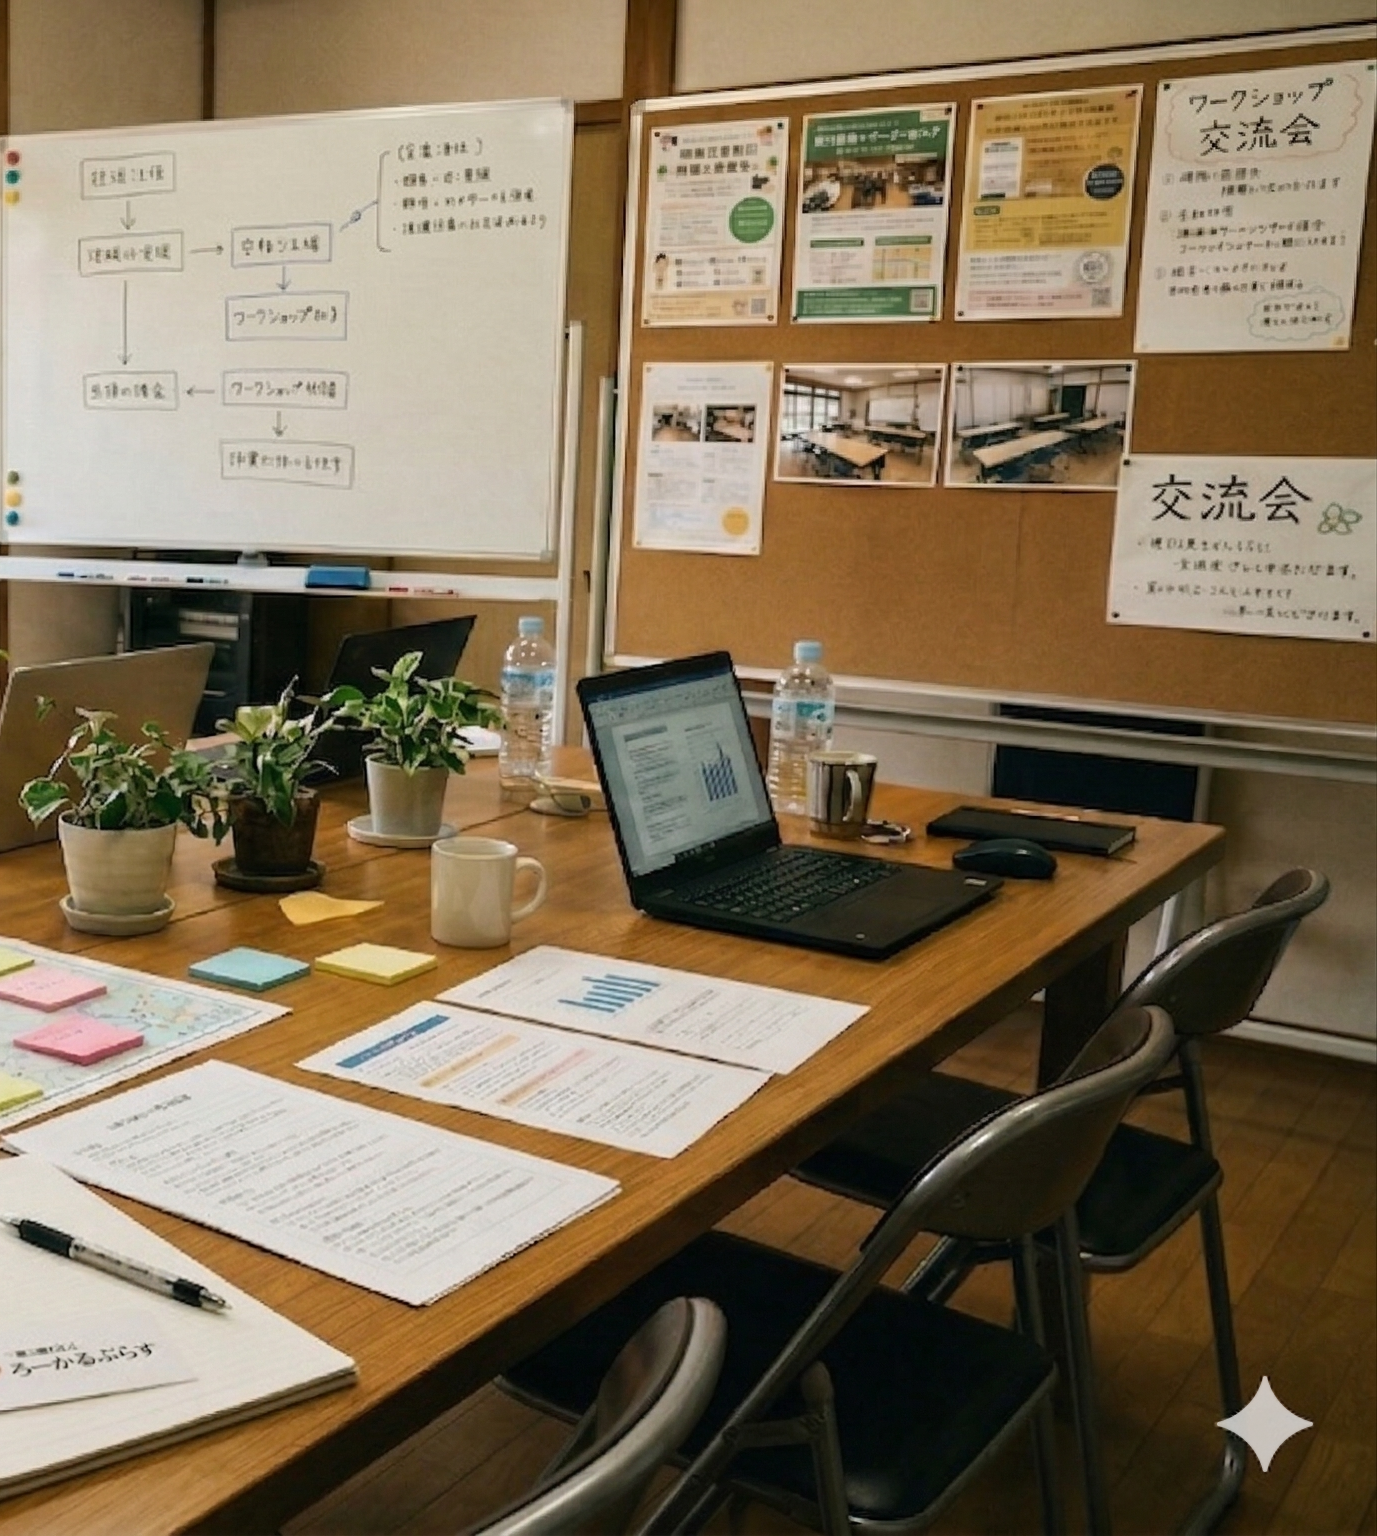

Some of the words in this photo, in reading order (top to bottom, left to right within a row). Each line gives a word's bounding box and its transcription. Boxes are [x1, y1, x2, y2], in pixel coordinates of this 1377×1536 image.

[1188, 77, 1334, 113] ワークショップ
[1200, 113, 1320, 158] 交流会
[1152, 473, 1313, 525] 交流会
